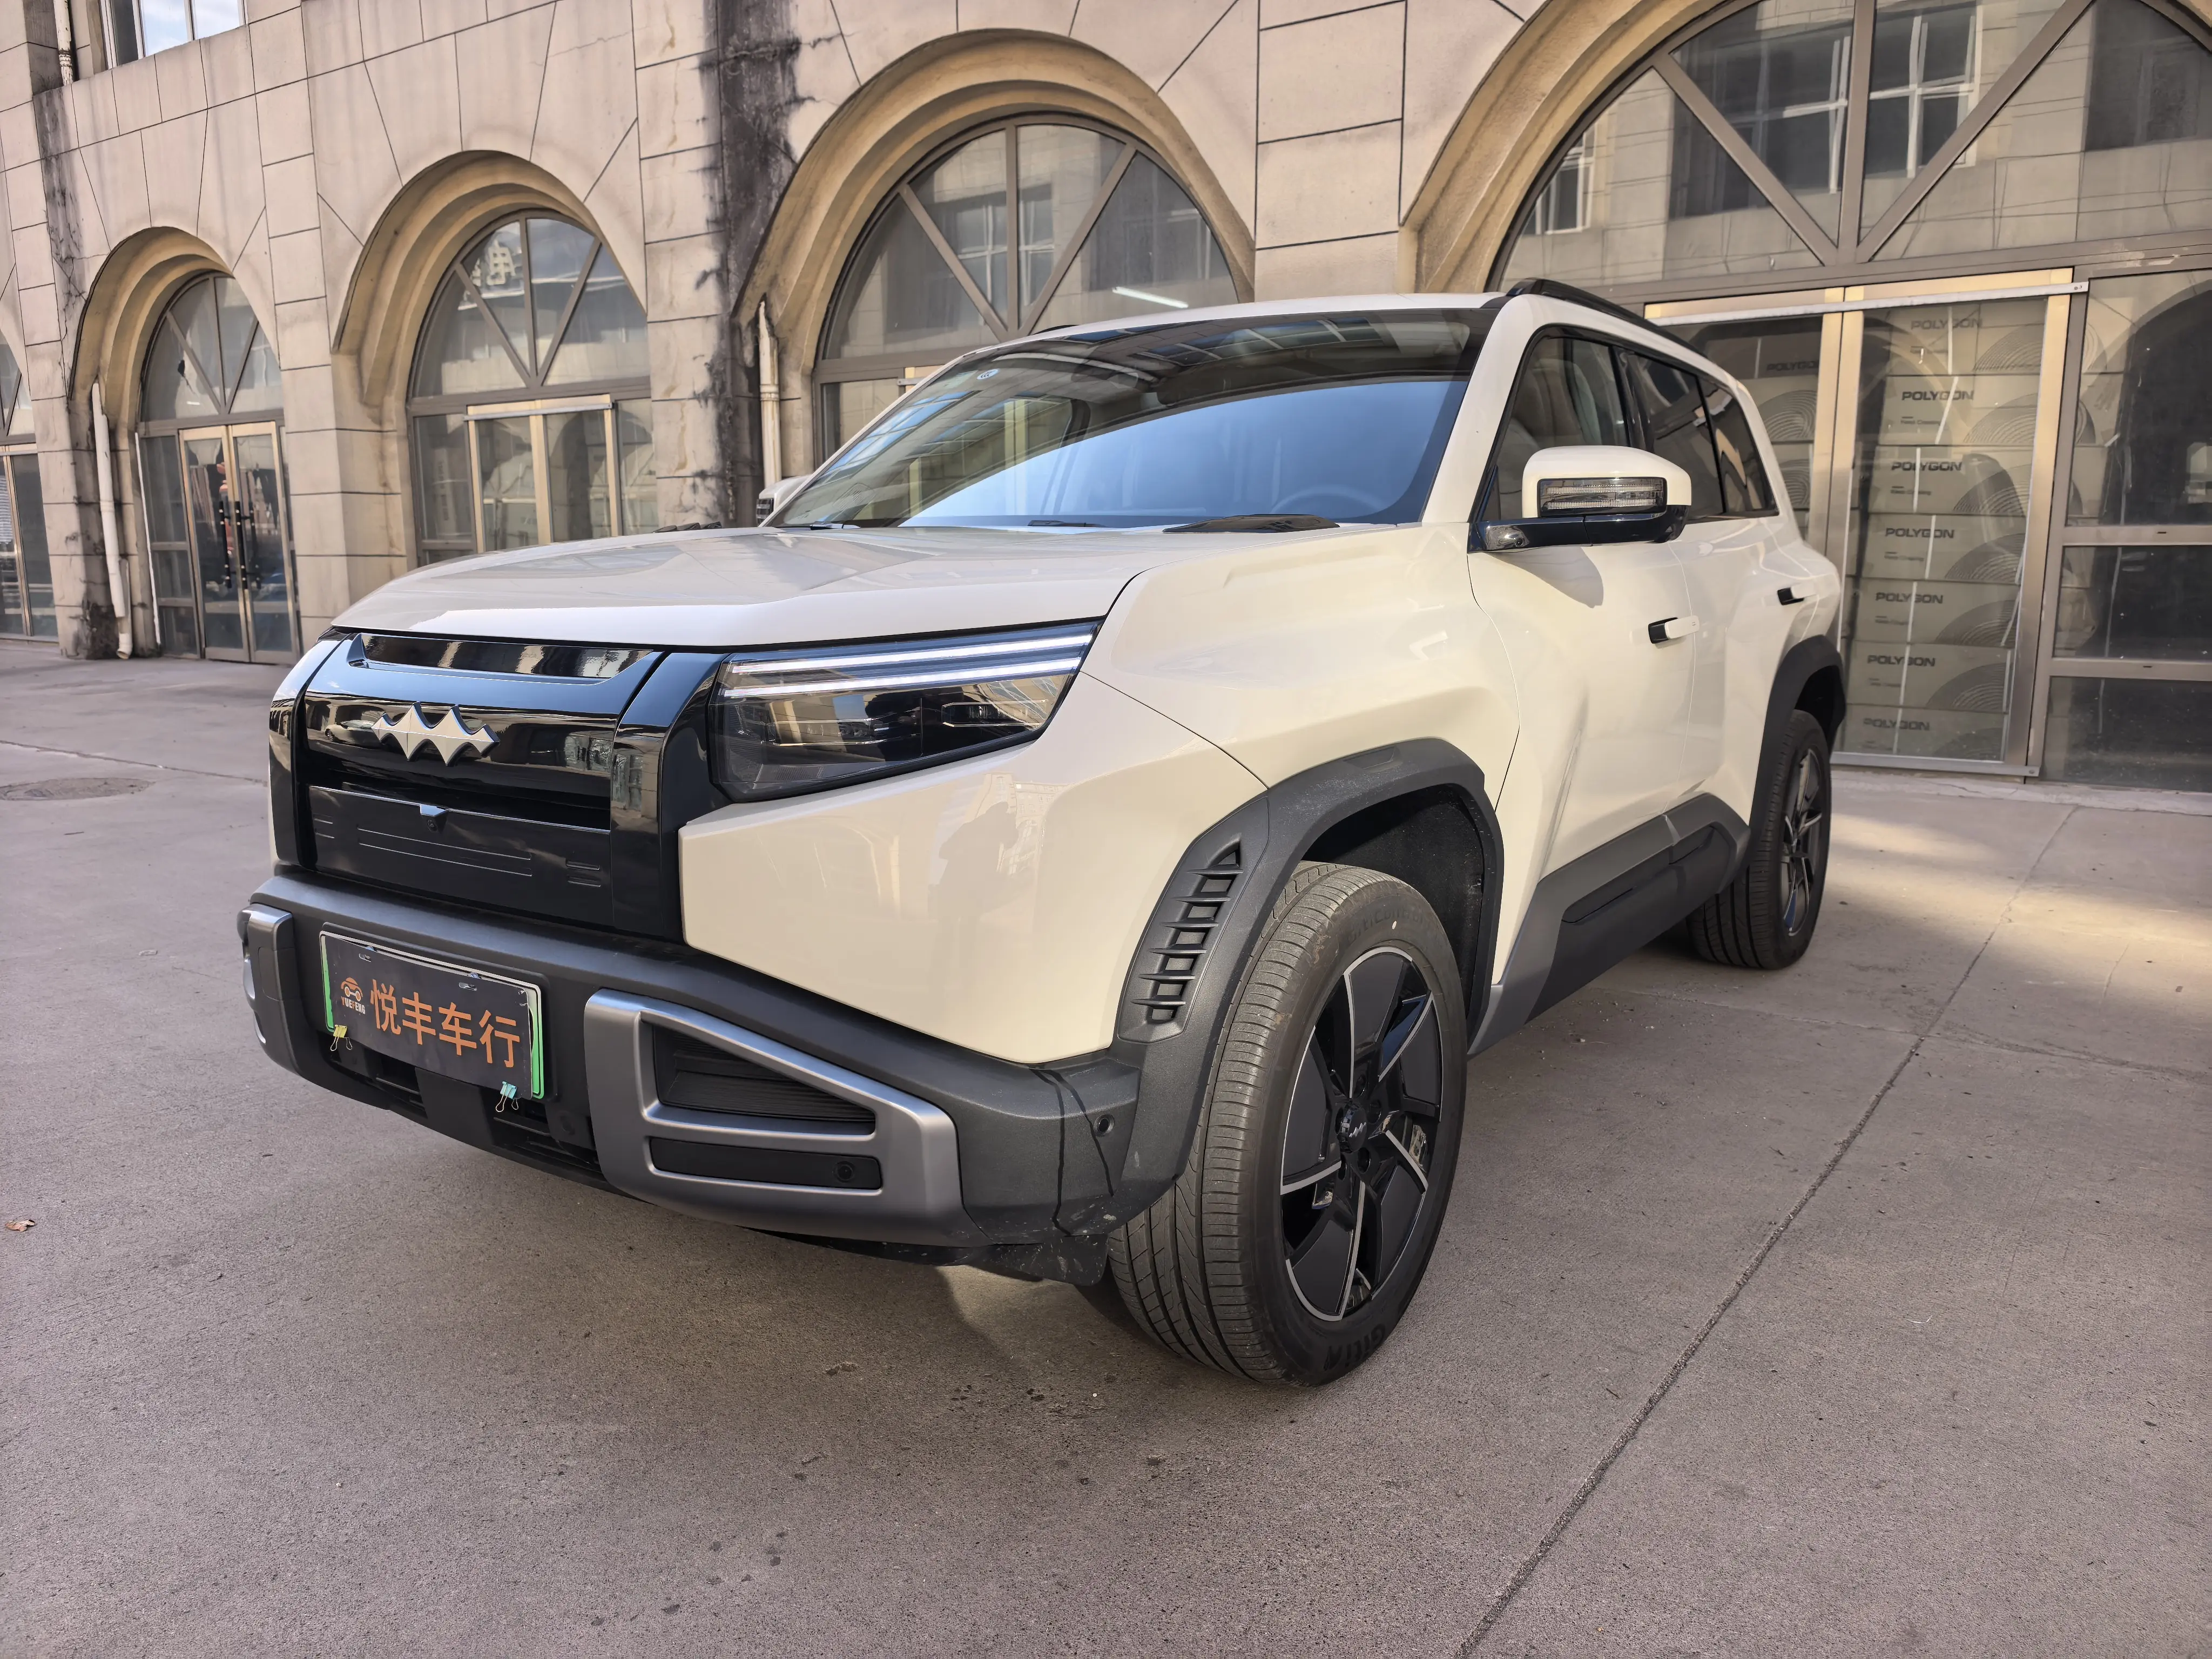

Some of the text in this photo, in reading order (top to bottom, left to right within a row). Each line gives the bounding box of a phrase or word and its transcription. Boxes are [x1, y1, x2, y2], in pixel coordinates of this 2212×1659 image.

[1766, 361, 1818, 371] POLYGO
[341, 996, 366, 1014] YUEFENG
[370, 979, 520, 1068] 悦丰车行
